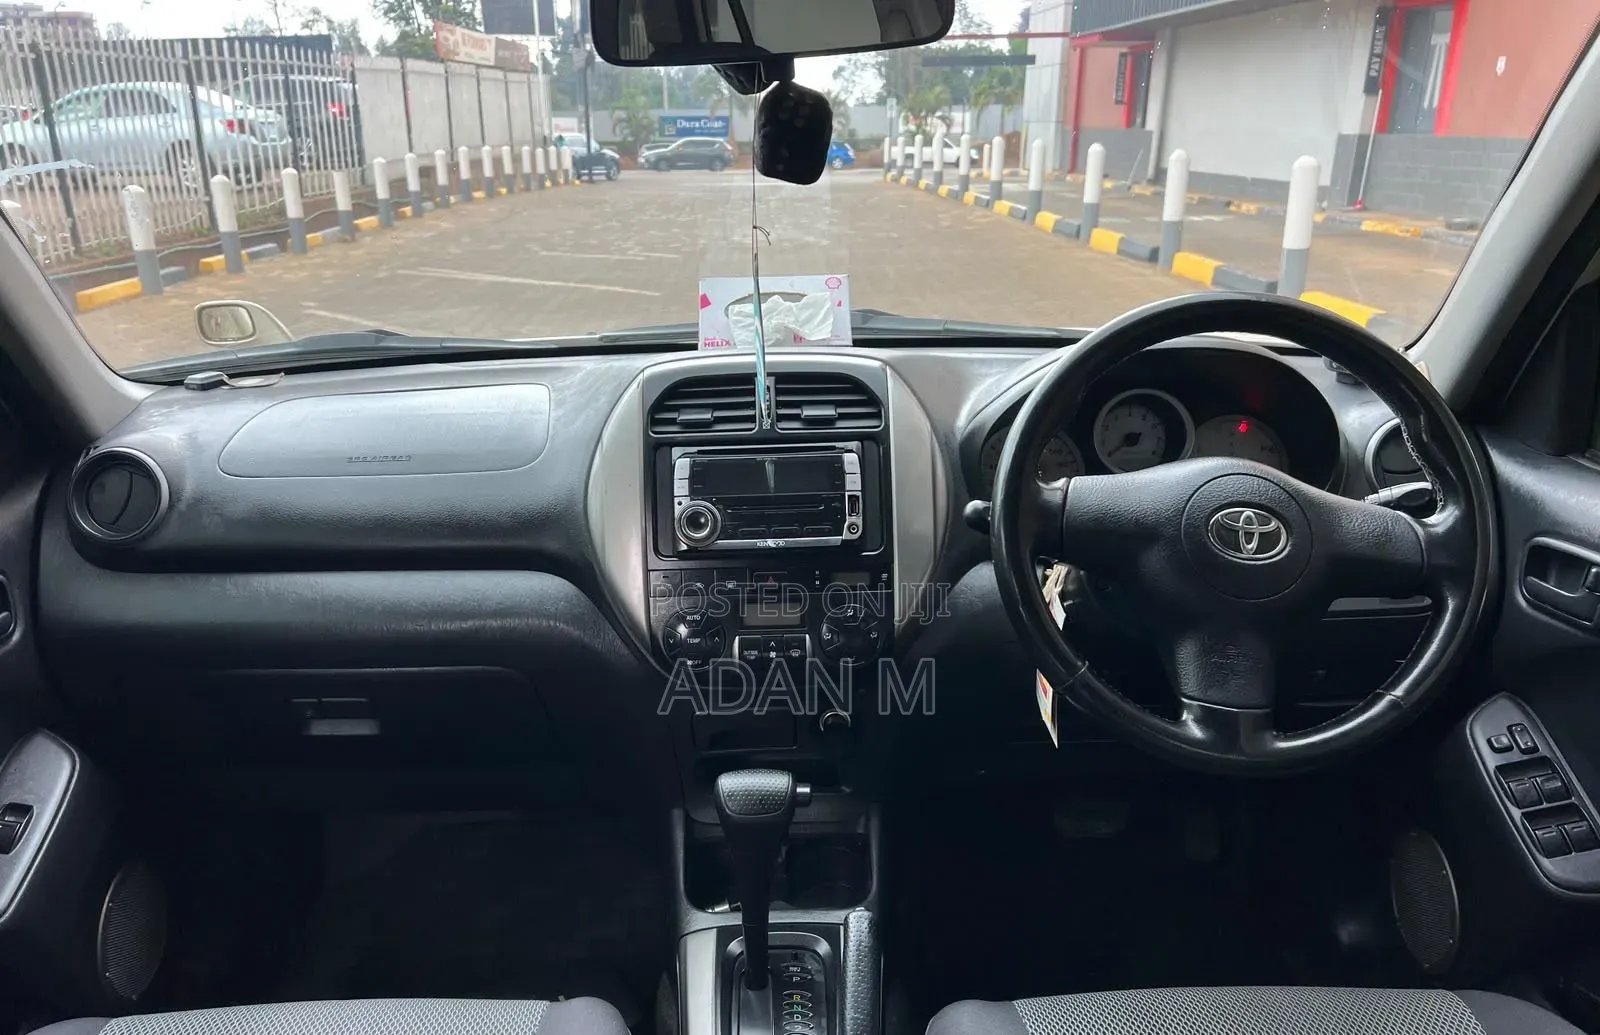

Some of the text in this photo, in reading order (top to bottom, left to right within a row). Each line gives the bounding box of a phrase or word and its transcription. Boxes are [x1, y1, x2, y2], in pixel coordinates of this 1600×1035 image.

[1369, 55, 1381, 77] PAY
[676, 119, 699, 129] Dura
[704, 339, 731, 348] HELIX
